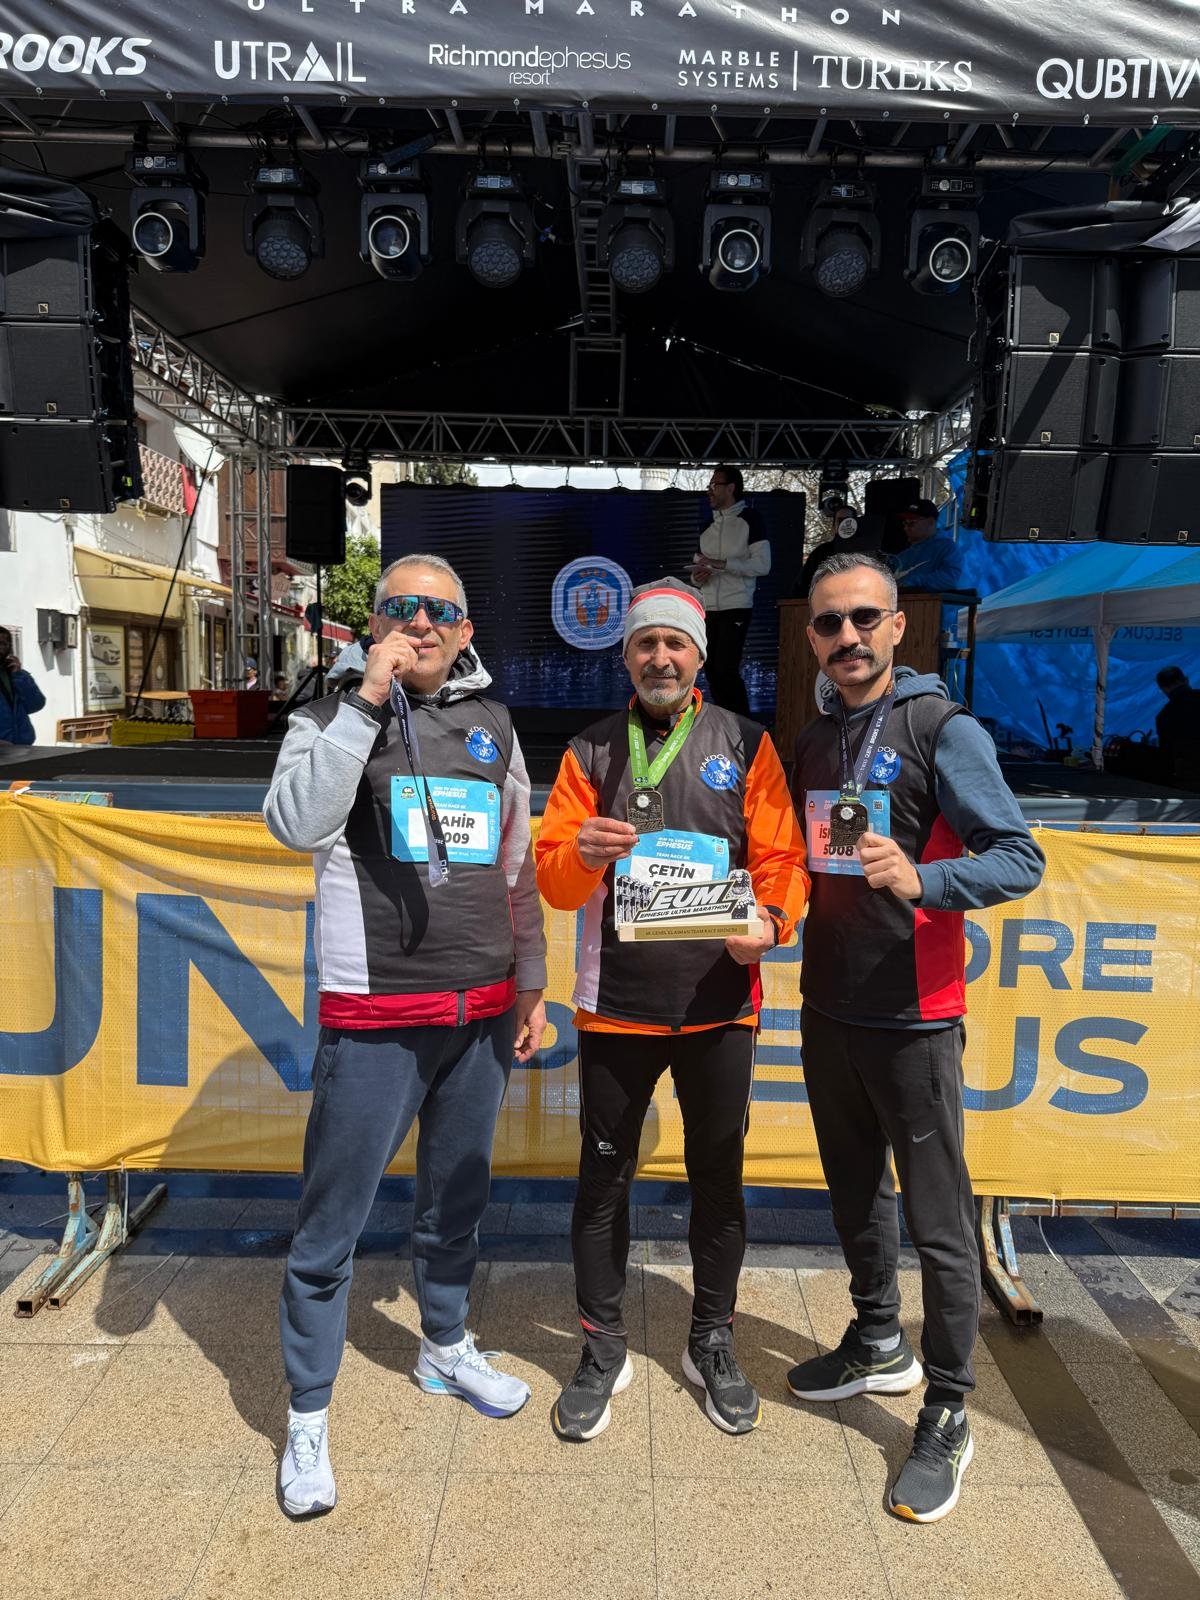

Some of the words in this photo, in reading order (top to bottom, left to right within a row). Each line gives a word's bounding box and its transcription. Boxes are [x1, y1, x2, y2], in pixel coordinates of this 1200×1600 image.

[247, 0, 469, 15] ULTRA
[525, 0, 903, 26] MARATHON
[214, 40, 367, 83] UTRAIL
[428, 44, 632, 73] Richmondephesus
[678, 49, 781, 68] MARBLE
[508, 70, 550, 86] resort
[677, 70, 780, 90] SYSTEMS
[812, 55, 974, 93] TUREKS
[440, 813, 475, 829] AHİR
[443, 832, 470, 845] 009
[656, 841, 694, 851] EPHESUS
[648, 863, 696, 879] ÇETİN
[650, 884, 728, 911] EUM
[640, 911, 670, 919] EPHESUS
[670, 908, 692, 916] ULTRA
[692, 904, 730, 913] MARATHON
